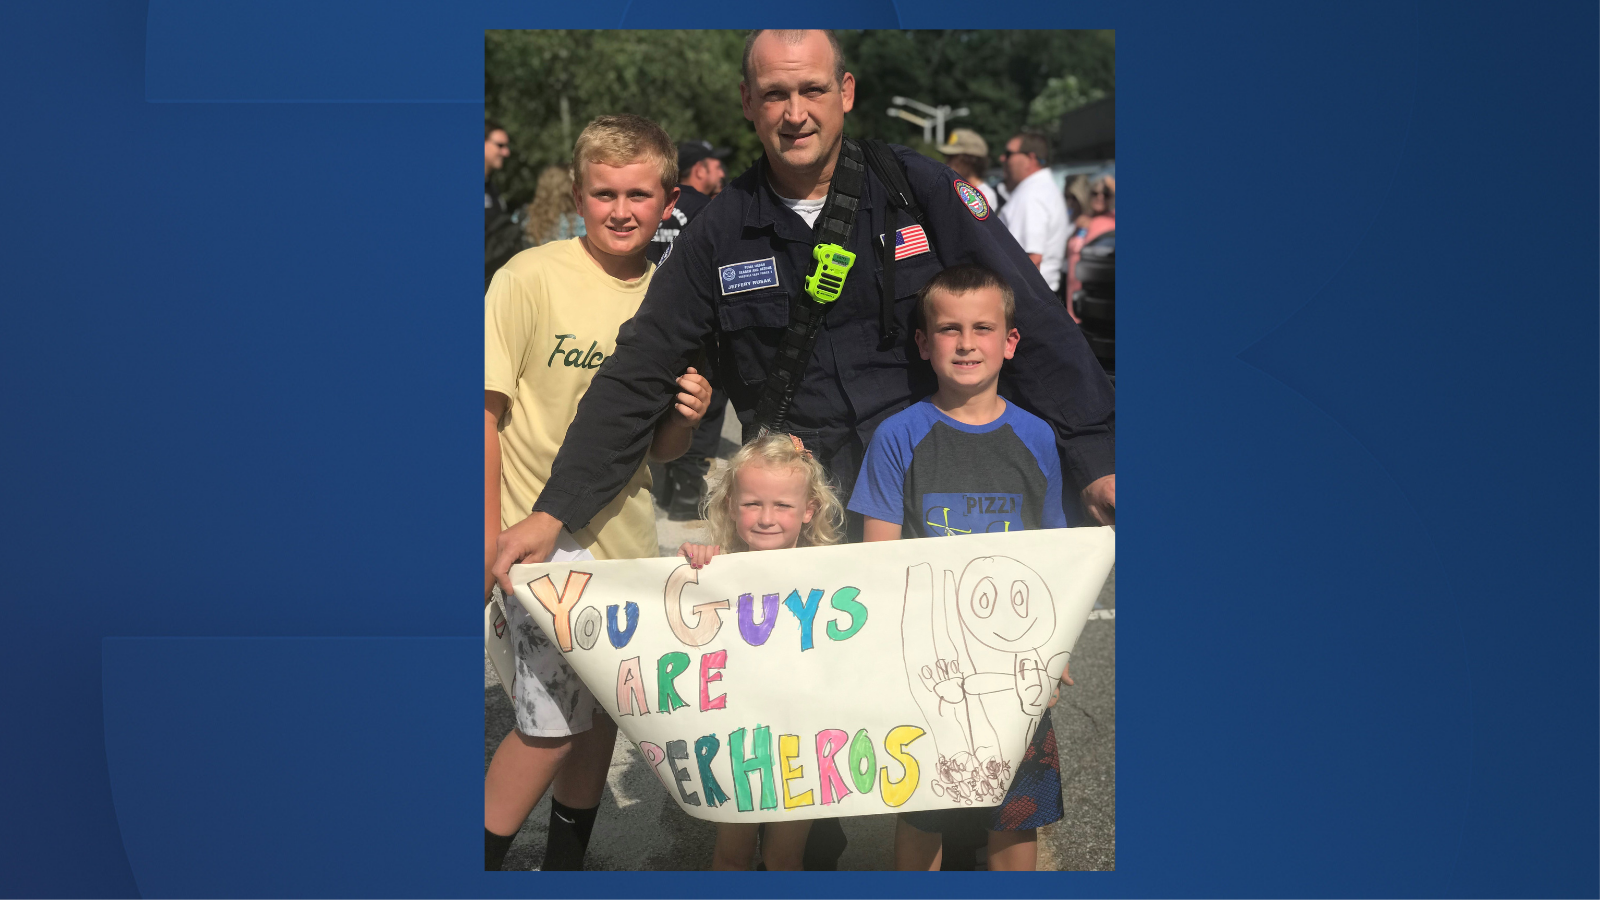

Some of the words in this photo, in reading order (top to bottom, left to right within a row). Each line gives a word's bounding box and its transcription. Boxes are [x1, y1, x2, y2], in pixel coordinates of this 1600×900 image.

[547, 333, 606, 369] Falc
[663, 562, 869, 652] GUYS
[615, 649, 729, 717] ARE
[637, 723, 927, 813] PERHEROS
